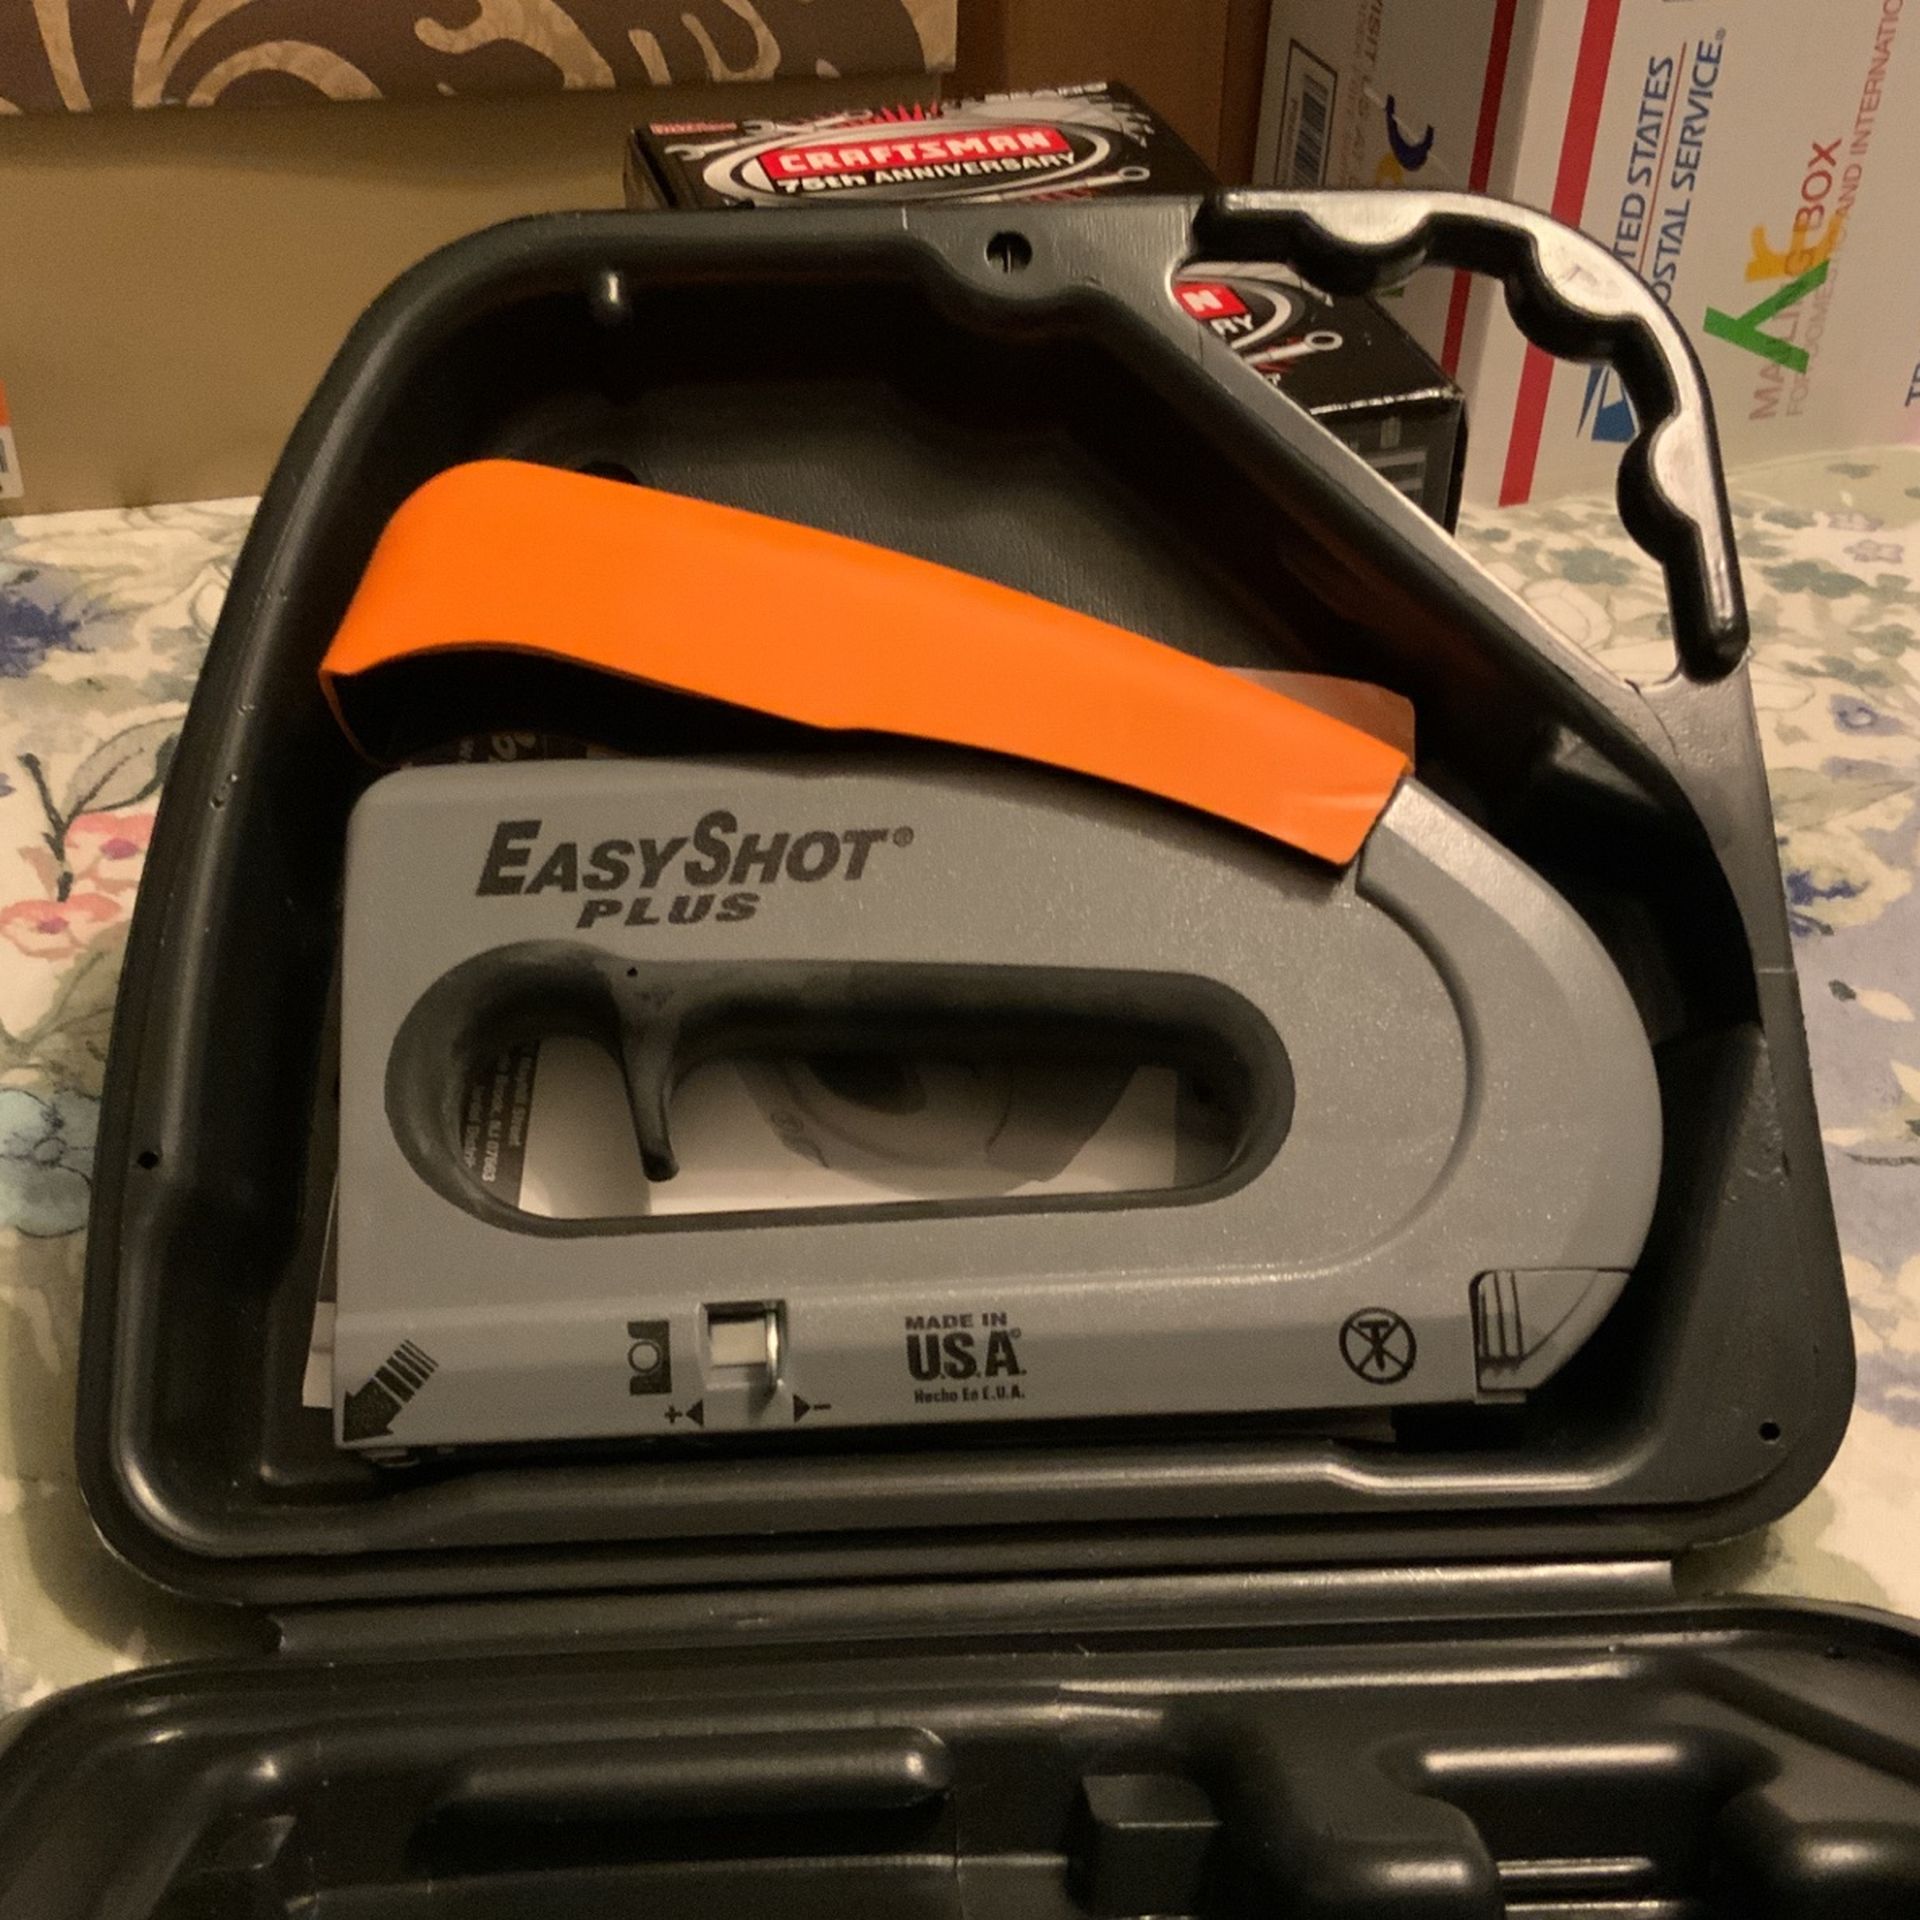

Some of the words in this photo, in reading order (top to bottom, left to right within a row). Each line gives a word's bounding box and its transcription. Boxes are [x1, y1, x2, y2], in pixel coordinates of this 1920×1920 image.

[1627, 56, 1674, 188] STATES
[779, 131, 1053, 173] CRAFTSMAN
[874, 152, 1076, 184] ANNIVERSARY
[1793, 138, 1843, 233] BOX
[1835, 163, 1863, 218] AND
[1612, 193, 1647, 260] TED
[1650, 199, 1691, 306] OSTAL
[576, 892, 760, 929] PLUS
[905, 1314, 974, 1331] MADE
[982, 1312, 1007, 1327] IN
